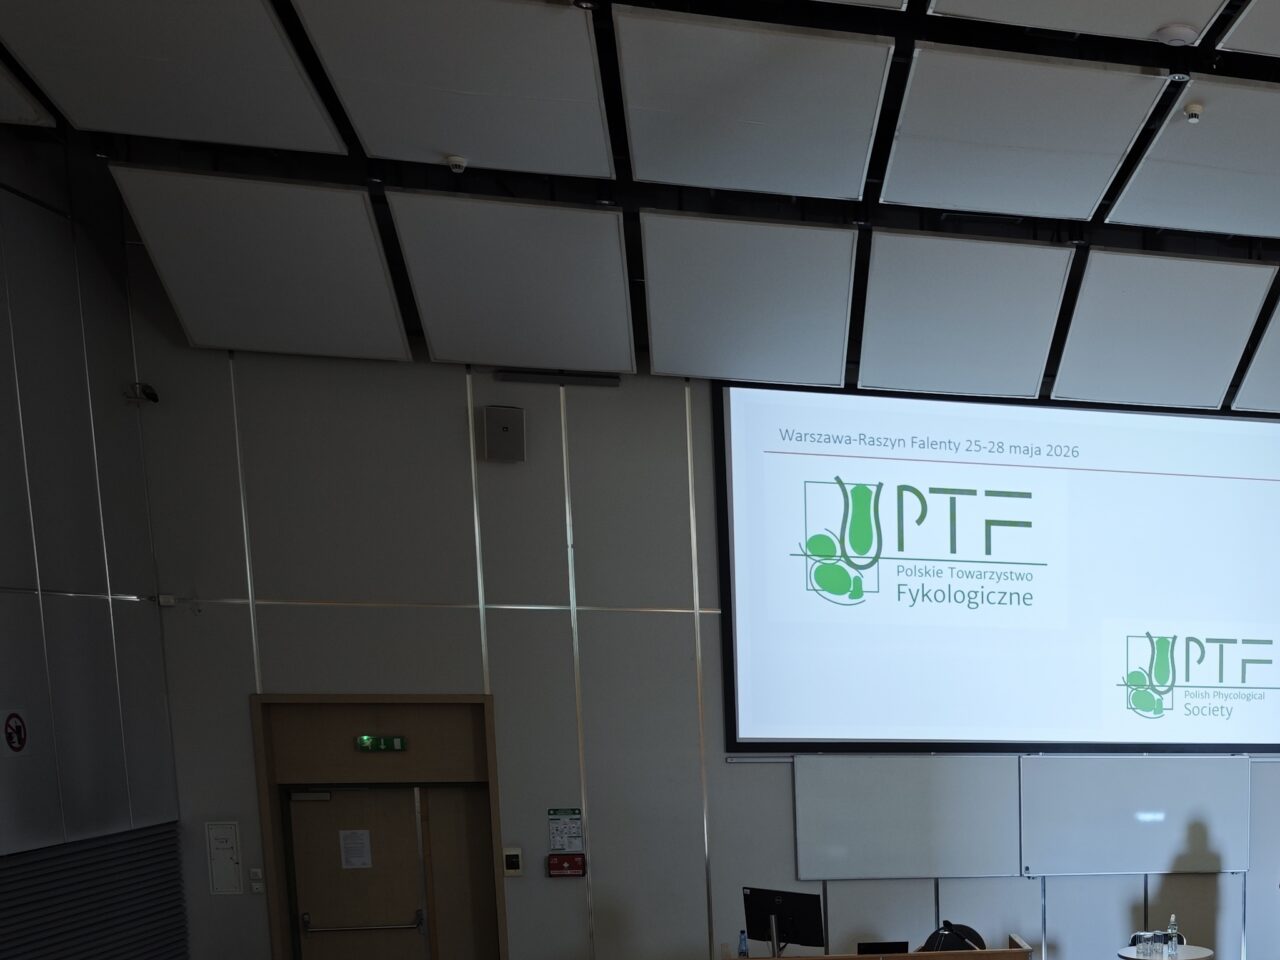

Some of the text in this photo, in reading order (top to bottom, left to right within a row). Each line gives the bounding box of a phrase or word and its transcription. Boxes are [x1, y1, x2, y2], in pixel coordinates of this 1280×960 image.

[778, 428, 1080, 459] Warszawa-Raszyn Falenty 25-28 maja 2026
[897, 484, 1033, 556] PTF
[896, 564, 1034, 584] Polskie Towarzystwo
[897, 583, 1034, 610] Fykologiczne
[1184, 690, 1266, 702] Polish Phycological
[1184, 703, 1234, 721] Society
